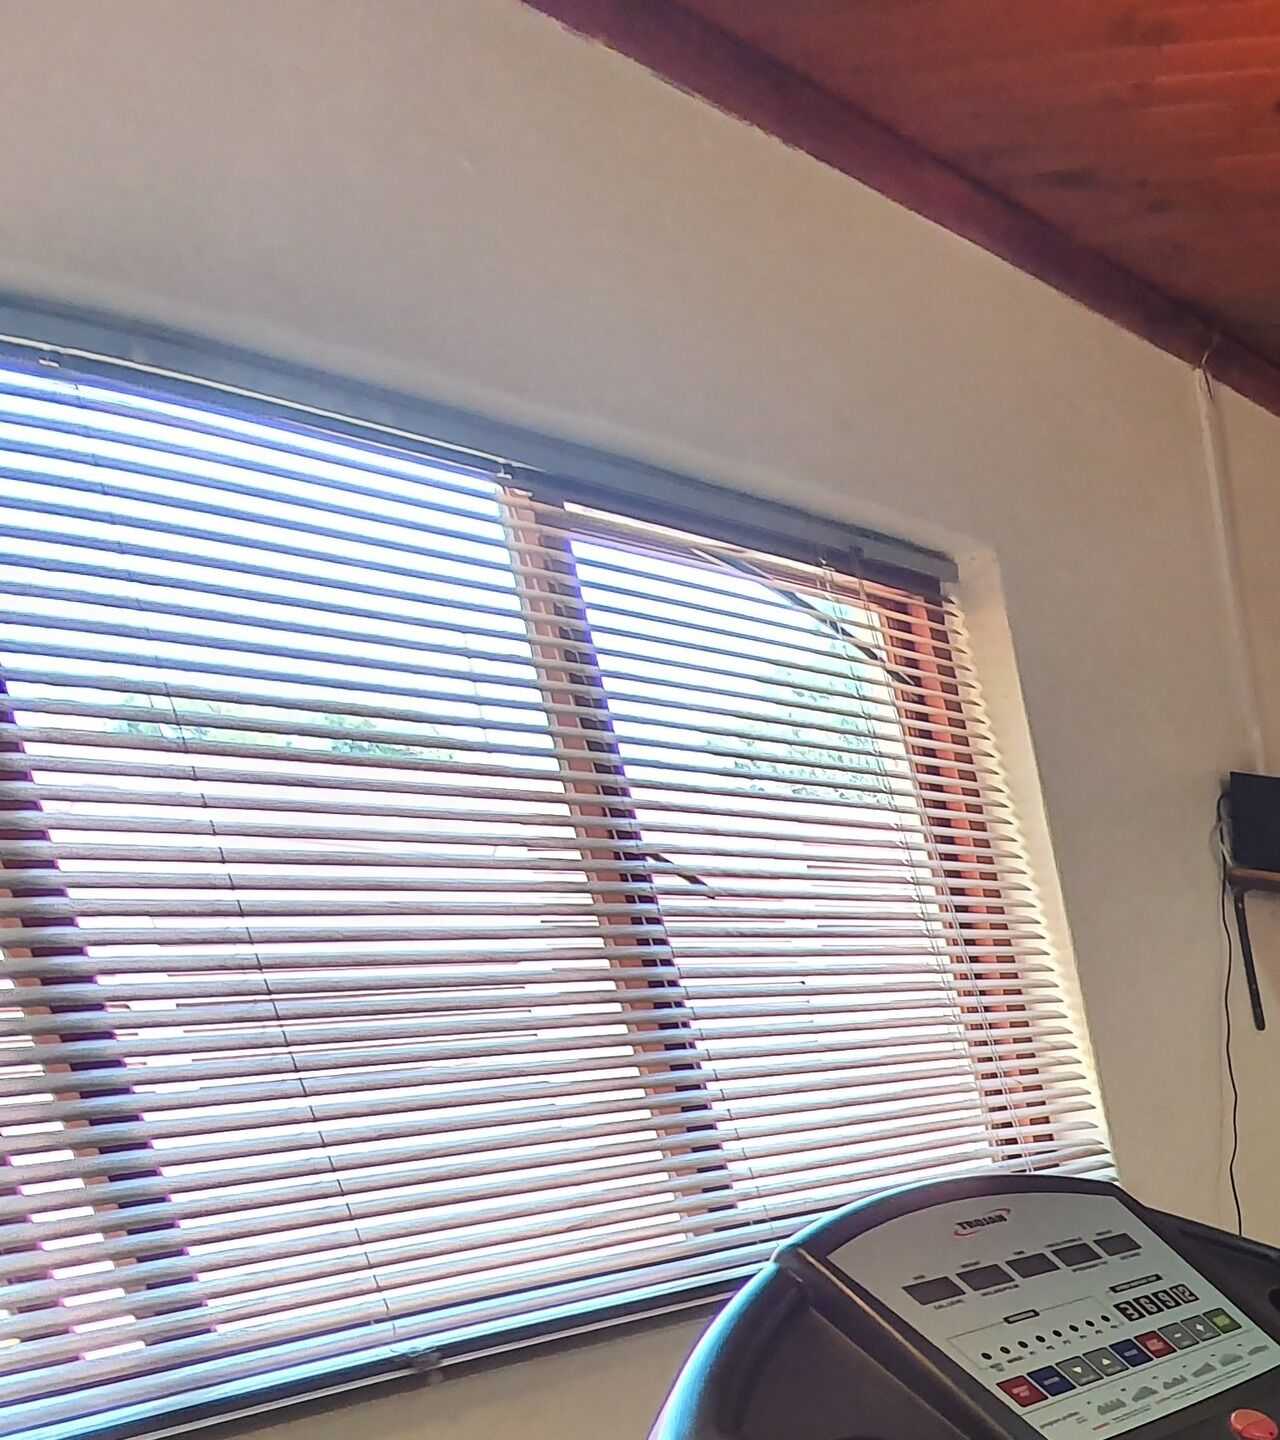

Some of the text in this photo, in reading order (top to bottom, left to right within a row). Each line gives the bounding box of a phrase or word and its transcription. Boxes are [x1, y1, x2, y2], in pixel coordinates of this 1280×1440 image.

[955, 1214, 1008, 1231] TROJAN
[1119, 1286, 1197, 1320] 3 6 9 12
